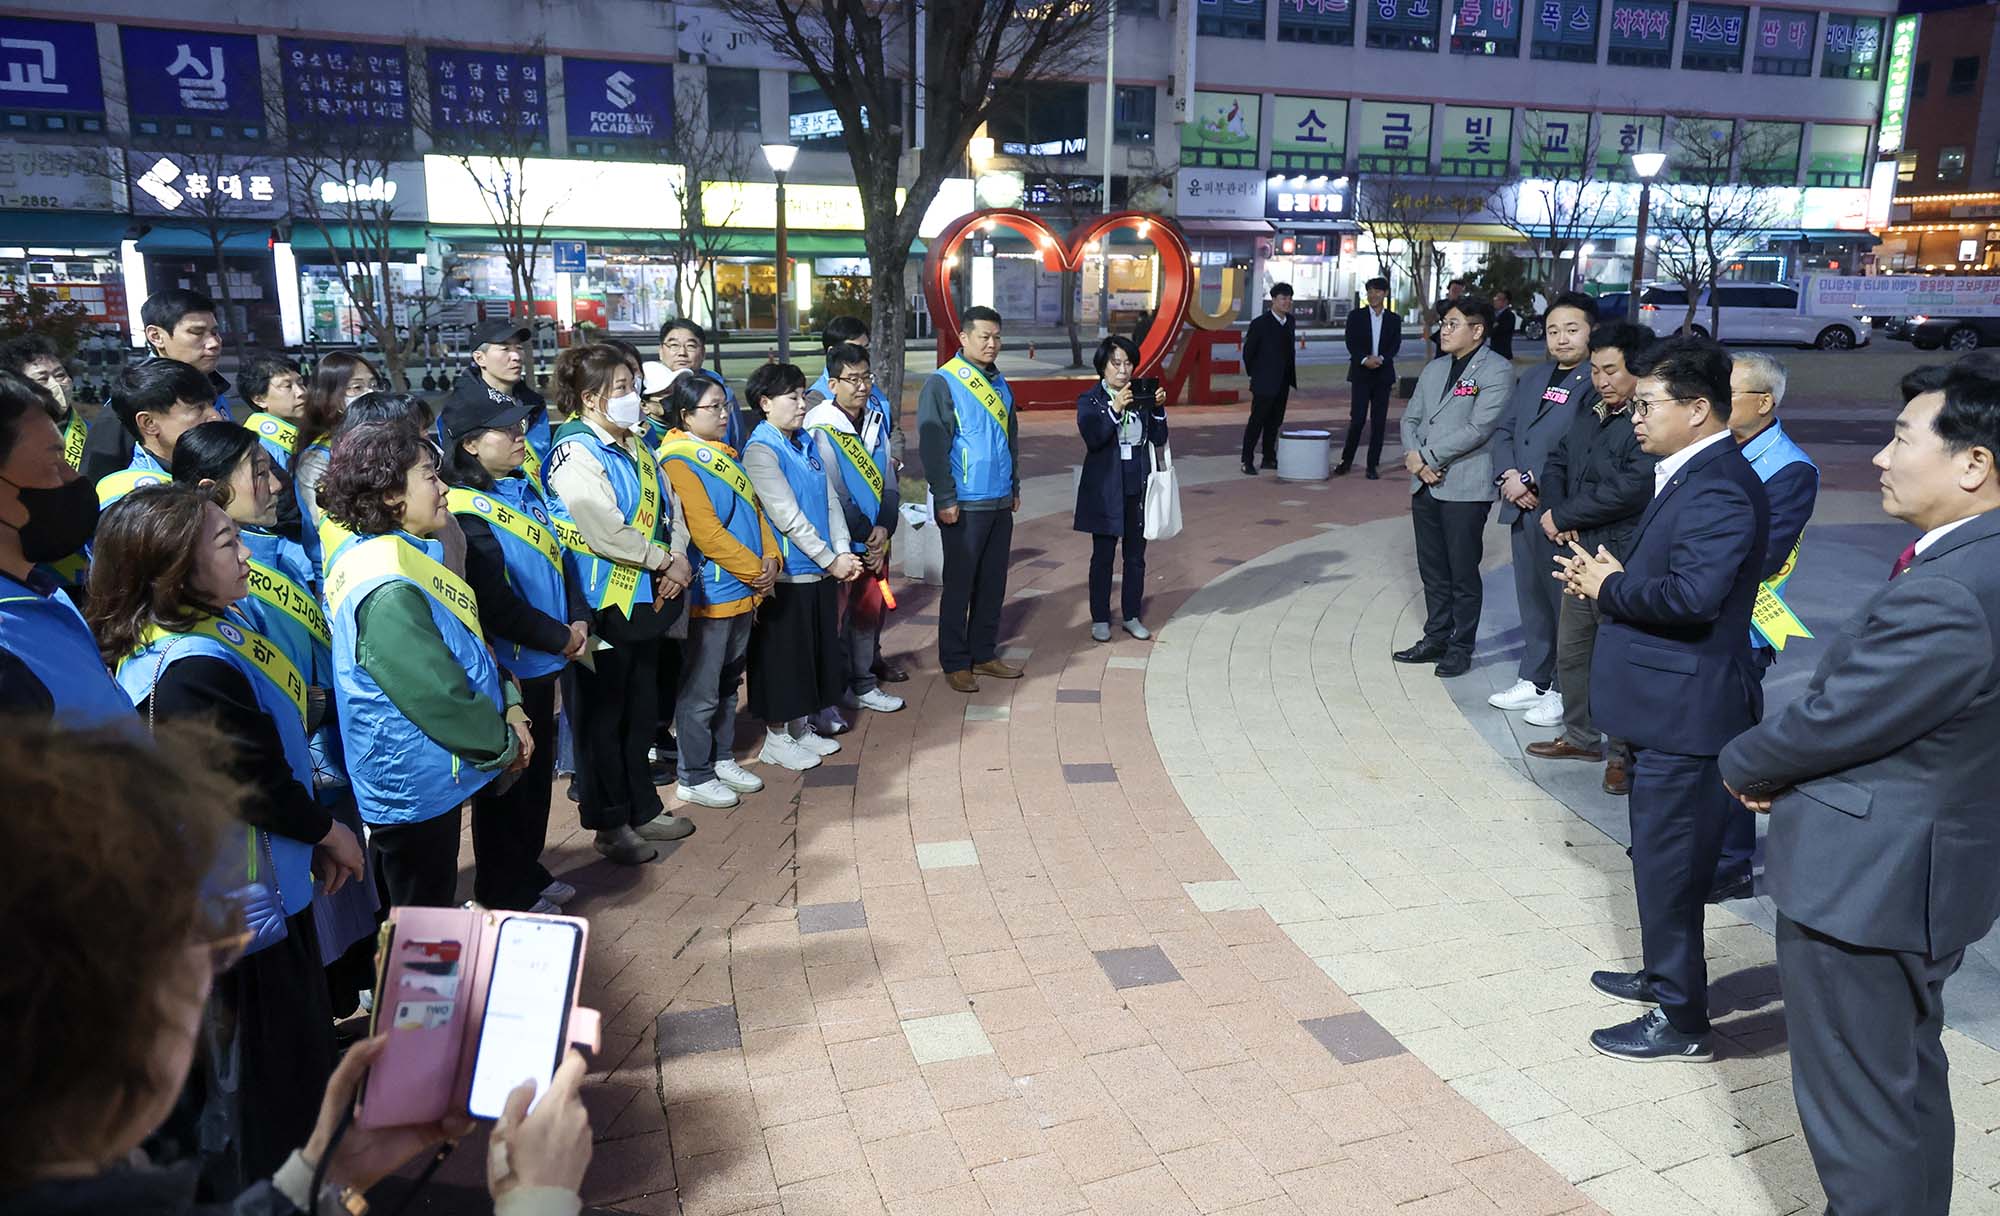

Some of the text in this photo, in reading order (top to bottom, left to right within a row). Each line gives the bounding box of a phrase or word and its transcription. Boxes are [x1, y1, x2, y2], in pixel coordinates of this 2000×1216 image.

[1614, 8, 1669, 40] 차차차
[1688, 14, 1742, 46] 퀵스탭
[590, 111, 655, 124] FOOTBALL
[590, 122, 655, 136] ACADEMY
[184, 172, 275, 201] 휴대폰
[574, 243, 583, 254] P
[636, 510, 655, 529] NO
